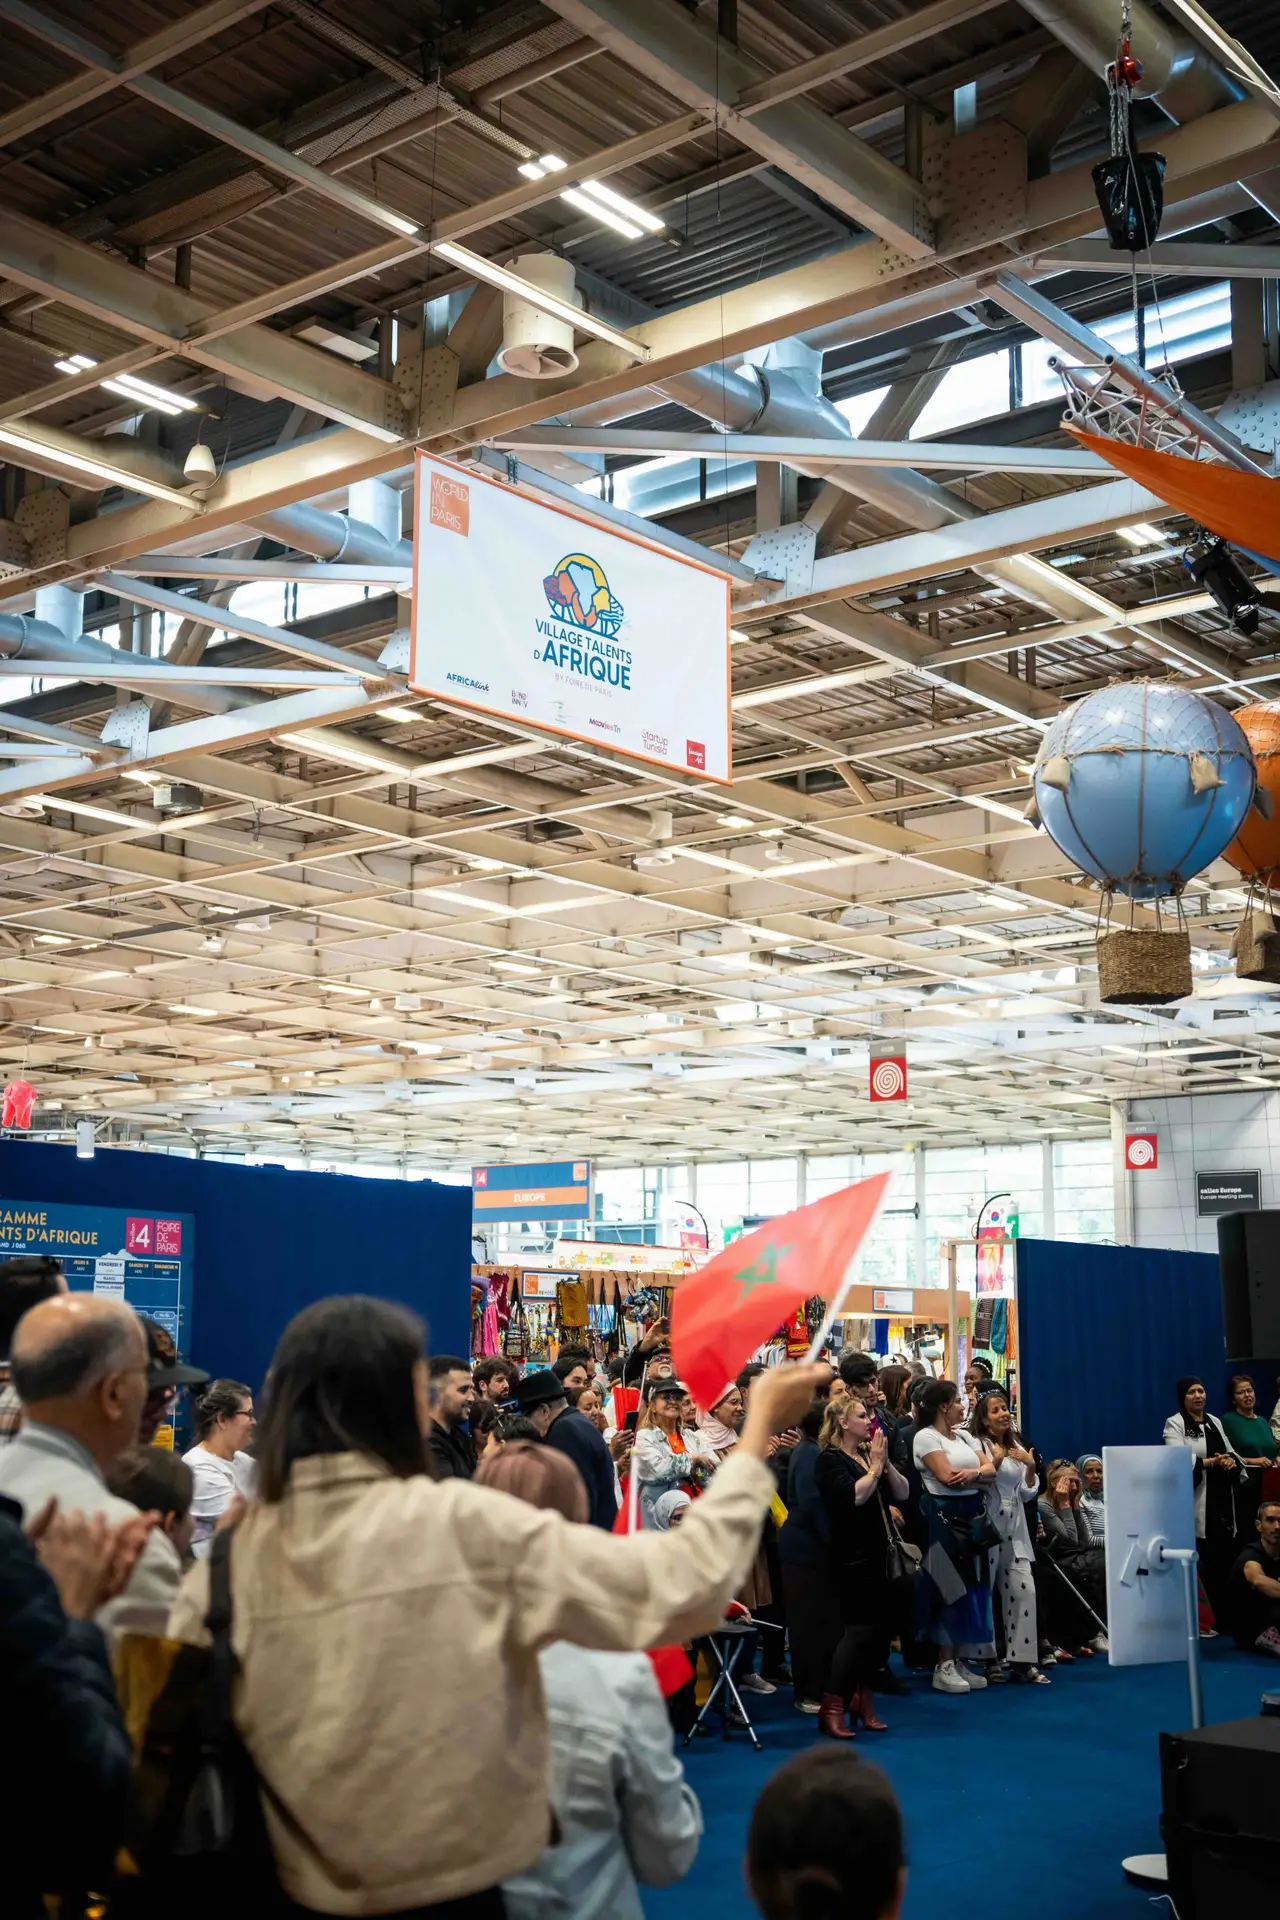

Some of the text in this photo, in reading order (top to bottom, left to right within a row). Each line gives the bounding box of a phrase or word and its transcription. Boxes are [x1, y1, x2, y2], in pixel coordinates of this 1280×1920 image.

[432, 476, 468, 502] WORLD
[432, 491, 445, 508] IN
[431, 506, 461, 529] PARIS
[535, 618, 632, 665] VILLAGE TALENTS
[554, 672, 613, 698] BY FOIRE DE PARIS
[641, 729, 669, 746] Startup
[643, 739, 667, 756] Tunisia
[513, 1192, 546, 1203] EUROPE
[156, 1221, 180, 1233] FOIRE
[26, 1227, 98, 1245] D'AFRIQUE
[135, 1224, 150, 1248] 4
[156, 1232, 168, 1243] DE
[156, 1242, 178, 1253] PARIS
